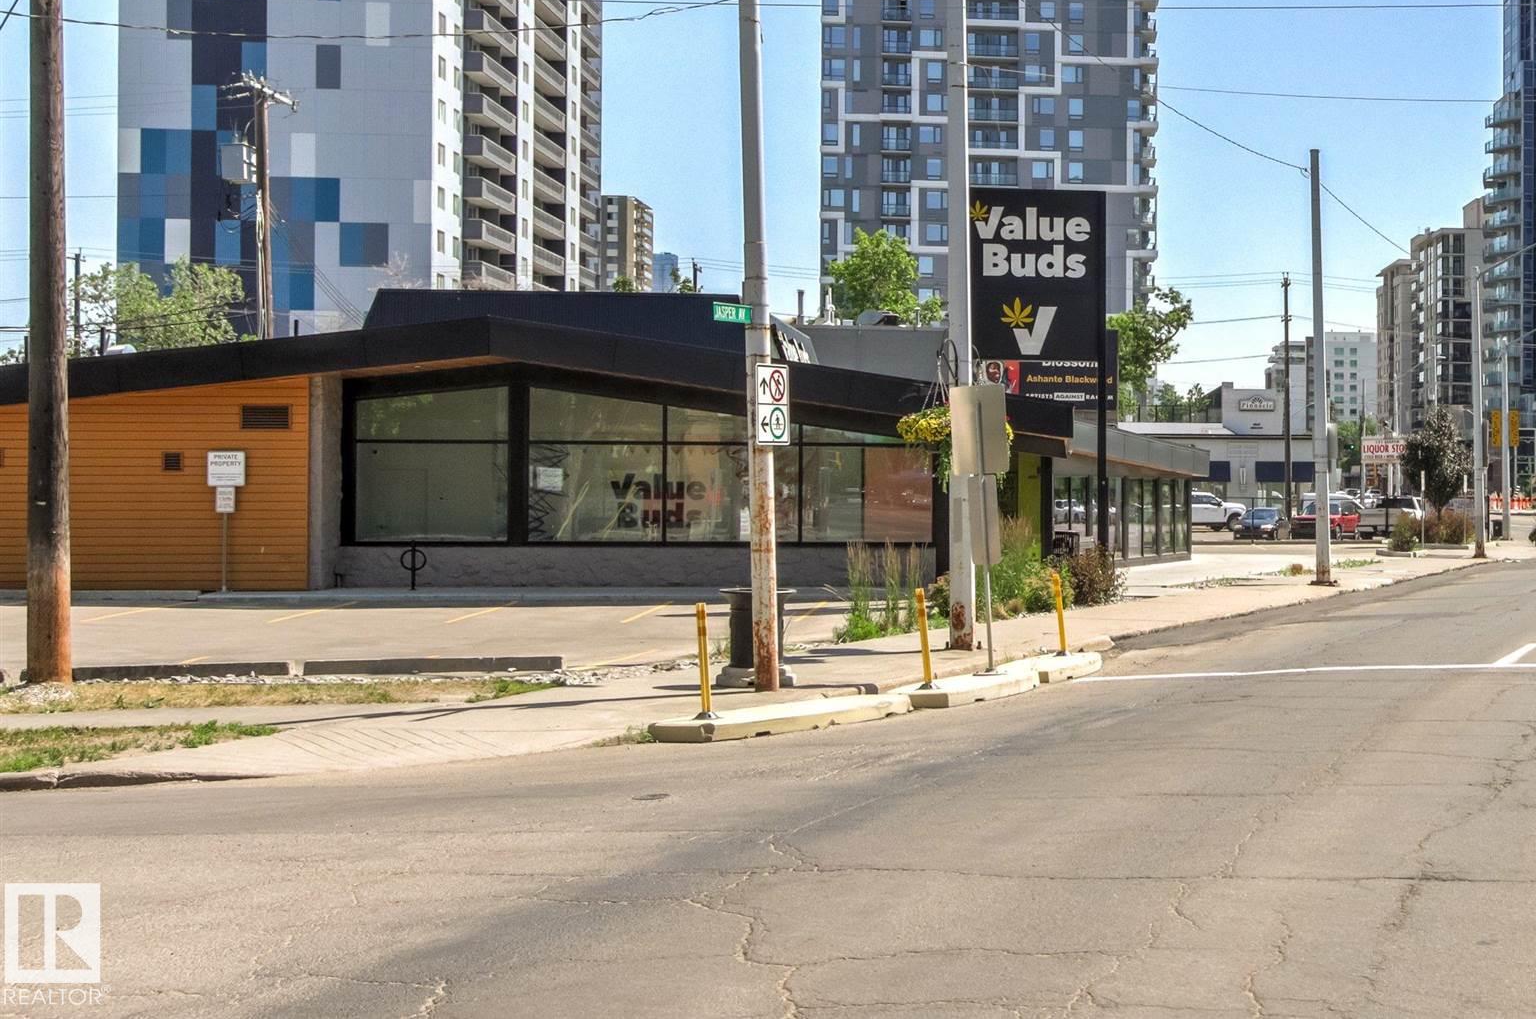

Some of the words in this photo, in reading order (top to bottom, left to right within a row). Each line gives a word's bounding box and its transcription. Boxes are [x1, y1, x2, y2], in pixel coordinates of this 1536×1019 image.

[974, 206, 1091, 242] Value
[982, 244, 1087, 278] Buds
[715, 305, 736, 321] JASPER
[739, 308, 746, 321] AV
[1065, 375, 1113, 384] Blackwd
[1363, 443, 1389, 454] LIQUOR
[610, 473, 707, 500] Value
